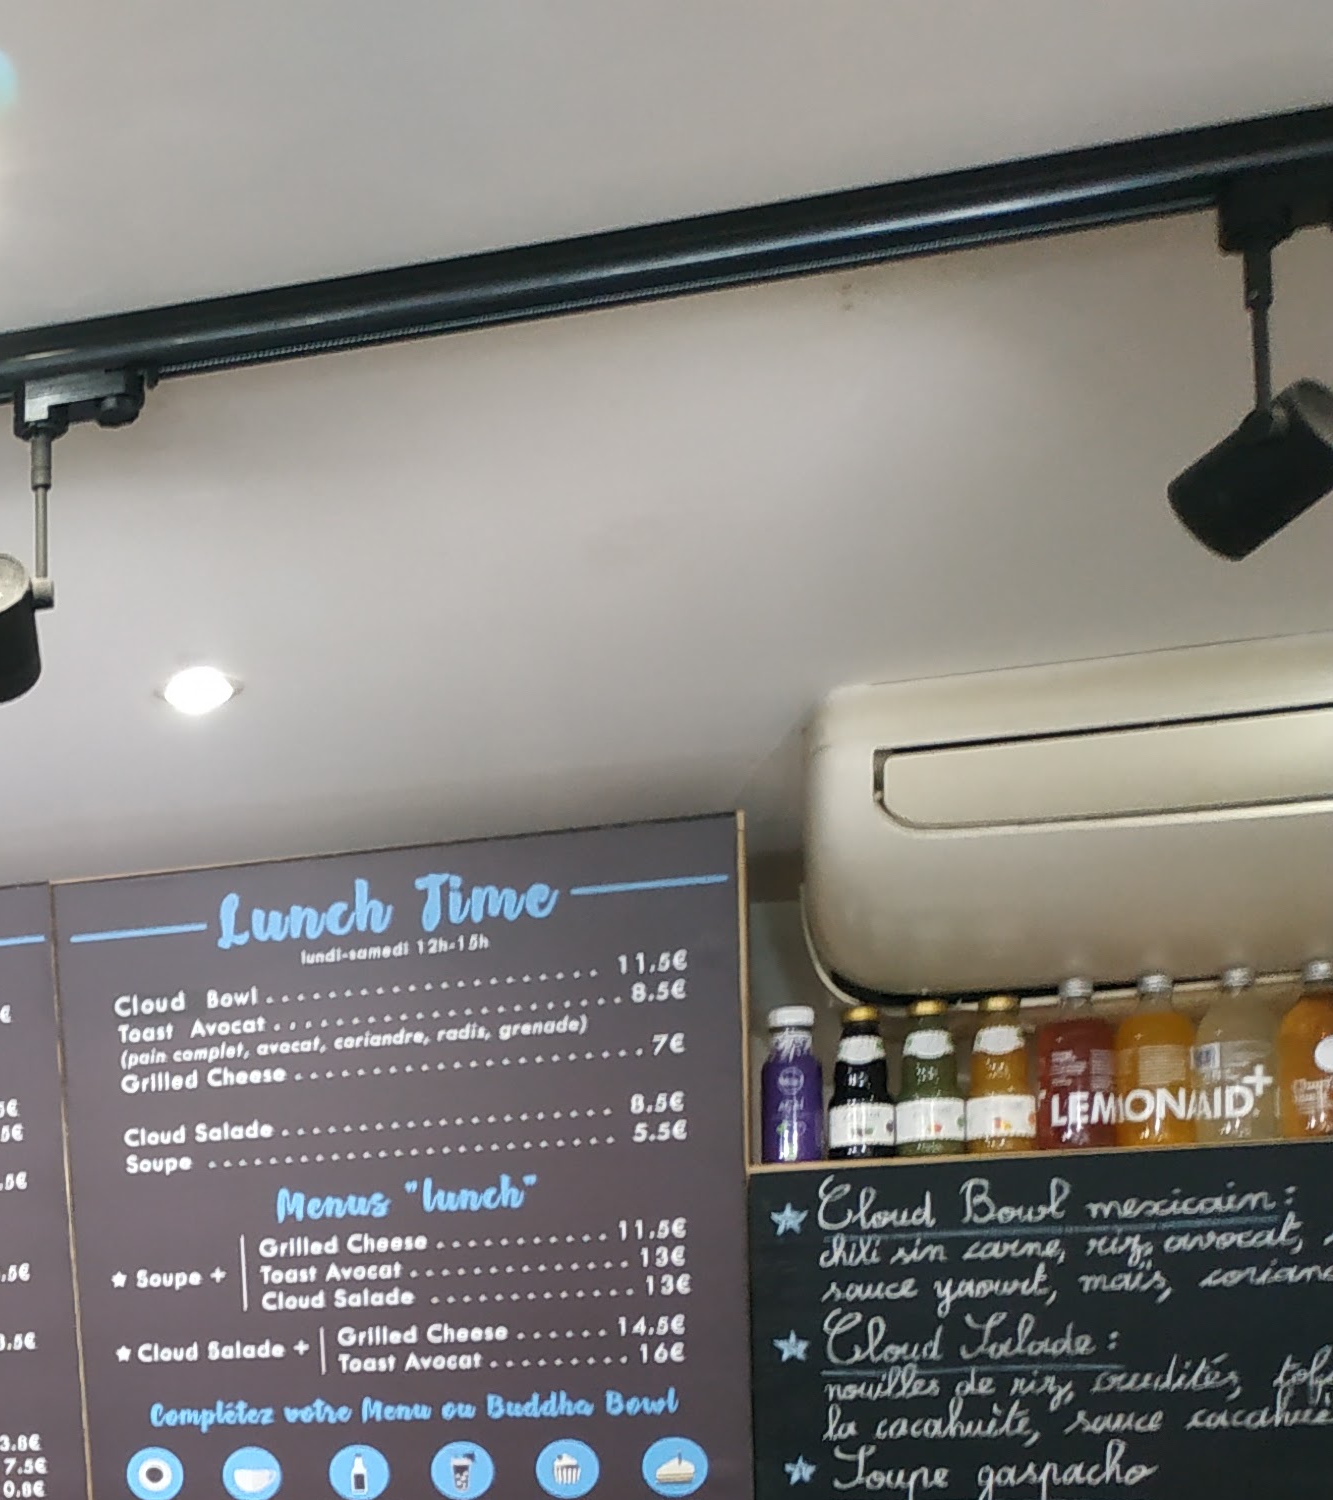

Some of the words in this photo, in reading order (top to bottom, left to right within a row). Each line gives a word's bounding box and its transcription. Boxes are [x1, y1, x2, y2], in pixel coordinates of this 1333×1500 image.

[217, 878, 393, 950] Lunch
[415, 872, 560, 931] Time
[114, 990, 185, 1017] Cloud
[207, 986, 258, 1009] Bowl
[118, 1023, 173, 1043] Toast
[190, 1016, 266, 1038] Avocat
[652, 1033, 685, 1056] 7€
[121, 1069, 198, 1093] Grilled
[207, 1066, 287, 1087] Cheese
[124, 1124, 186, 1147] Cloud
[195, 1119, 274, 1142] Salade
[126, 1154, 193, 1176] Soupe
[277, 1188, 391, 1224] Menus
[817, 1174, 937, 1230] Cloud
[959, 1177, 1071, 1225] Bowl
[640, 1245, 685, 1267] 13€
[640, 1342, 685, 1363] 16€
[150, 1400, 274, 1433] Complétez
[284, 1398, 352, 1424] votre
[361, 1396, 432, 1424] Menu
[441, 1402, 476, 1421] ou
[487, 1390, 594, 1419] Buddha
[605, 1387, 679, 1416] Bowl
